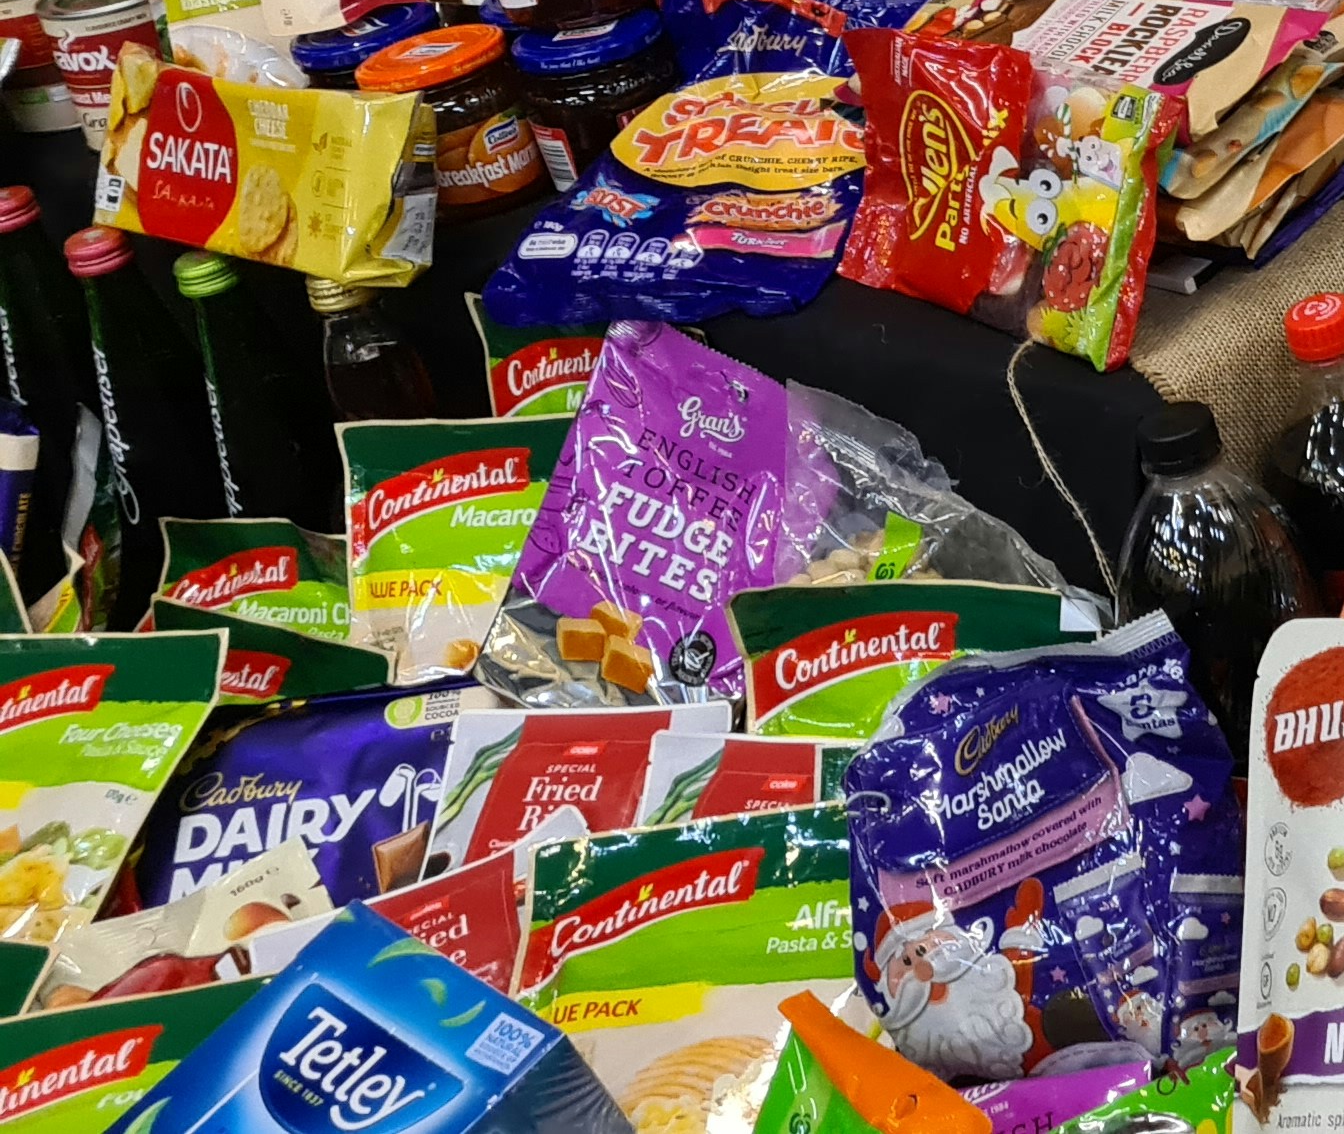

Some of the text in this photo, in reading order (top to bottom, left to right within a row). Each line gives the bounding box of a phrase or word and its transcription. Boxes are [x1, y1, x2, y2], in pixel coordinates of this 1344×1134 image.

[149, 132, 232, 184] SAKATA
[704, 200, 825, 219] crunchie
[368, 457, 518, 529] Continental
[600, 482, 733, 570] FUDGE
[577, 518, 718, 602] BITES
[237, 595, 328, 624] Macaroni
[774, 621, 940, 685] Continental
[522, 777, 600, 802] Fried
[546, 763, 596, 775] SPECIAL
[173, 787, 378, 864] DAIRY
[977, 779, 1046, 831] Santa
[583, 998, 639, 1020] PACK
[279, 1005, 429, 1131] Tetley
[1277, 1113, 1322, 1127] Aromatic
